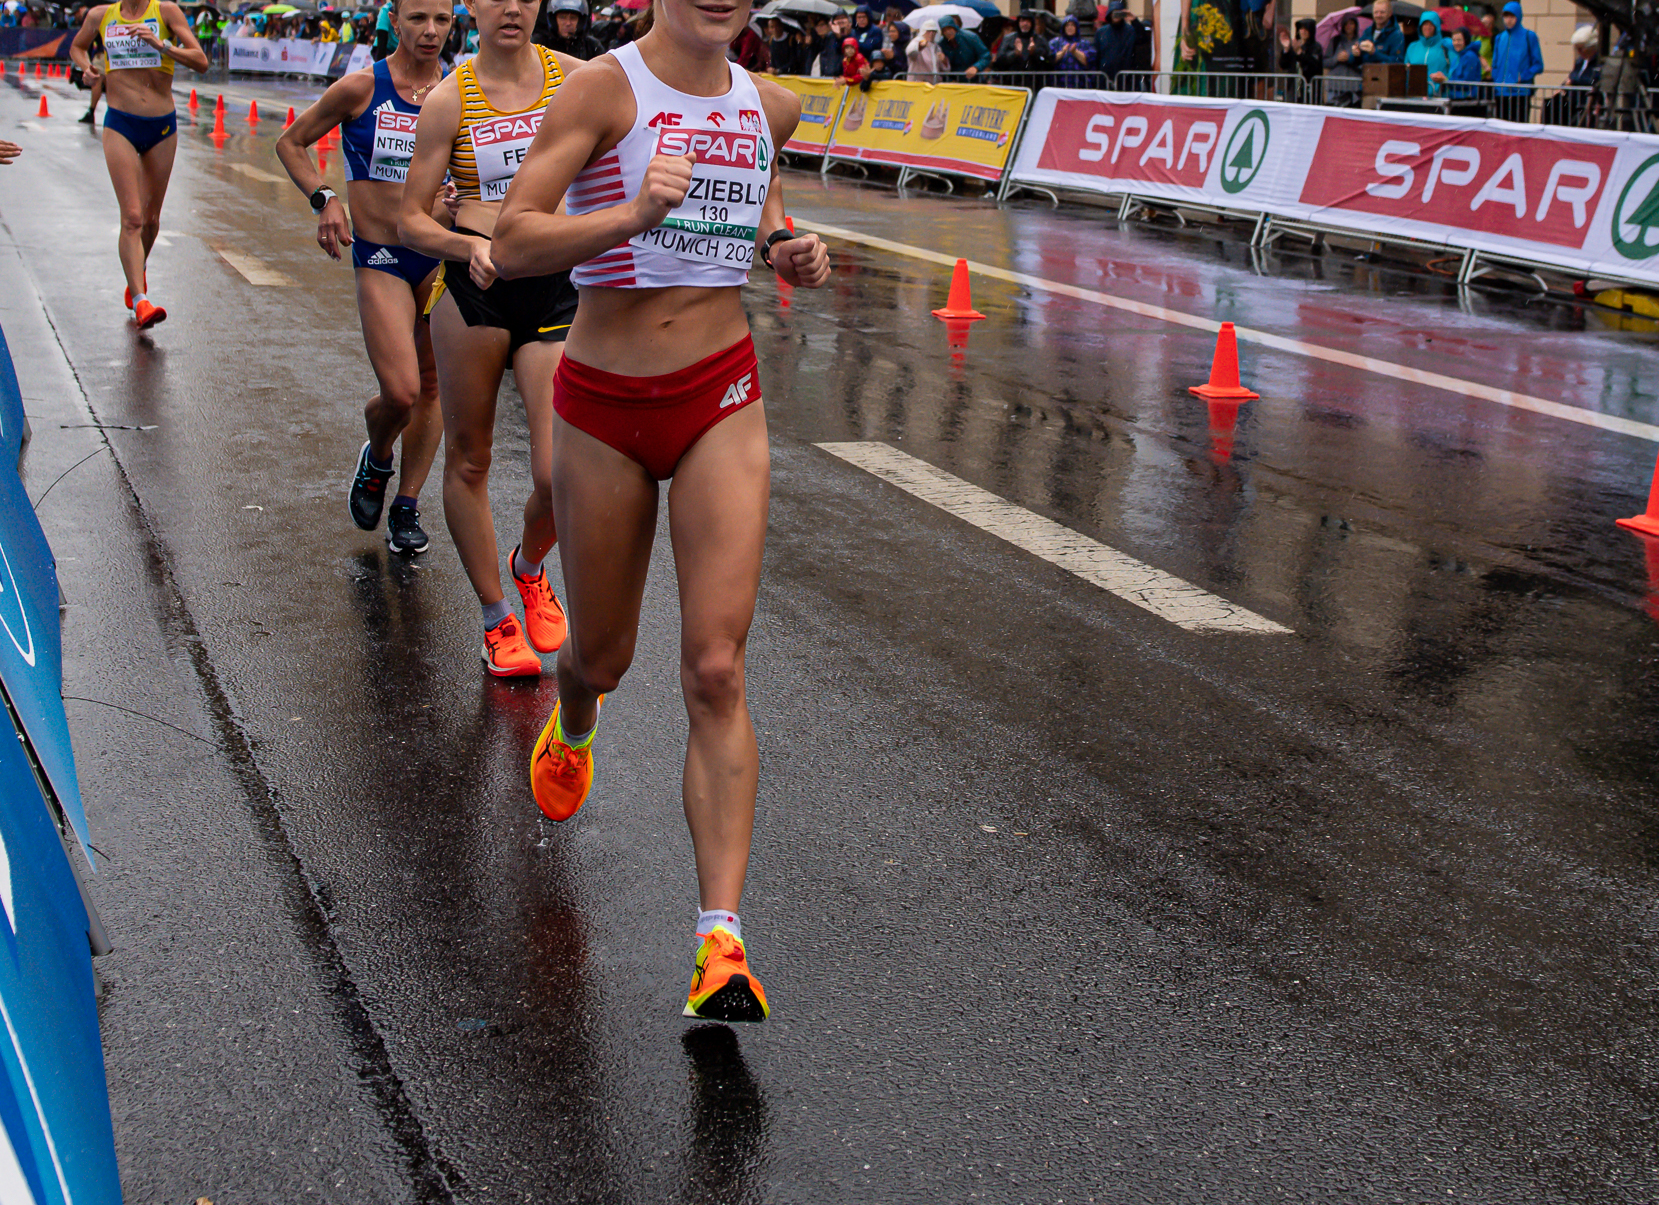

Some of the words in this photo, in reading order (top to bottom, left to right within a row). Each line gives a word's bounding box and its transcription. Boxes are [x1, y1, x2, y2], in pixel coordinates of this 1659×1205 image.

[957, 127, 998, 141] SWITZERLAND
[1078, 113, 1218, 173] SPAR
[503, 147, 529, 166] FE
[660, 132, 755, 164] SPAR
[375, 166, 408, 180] MUNI
[1365, 139, 1601, 229] SPAR
[699, 205, 728, 223] 130
[683, 220, 710, 233] RUN
